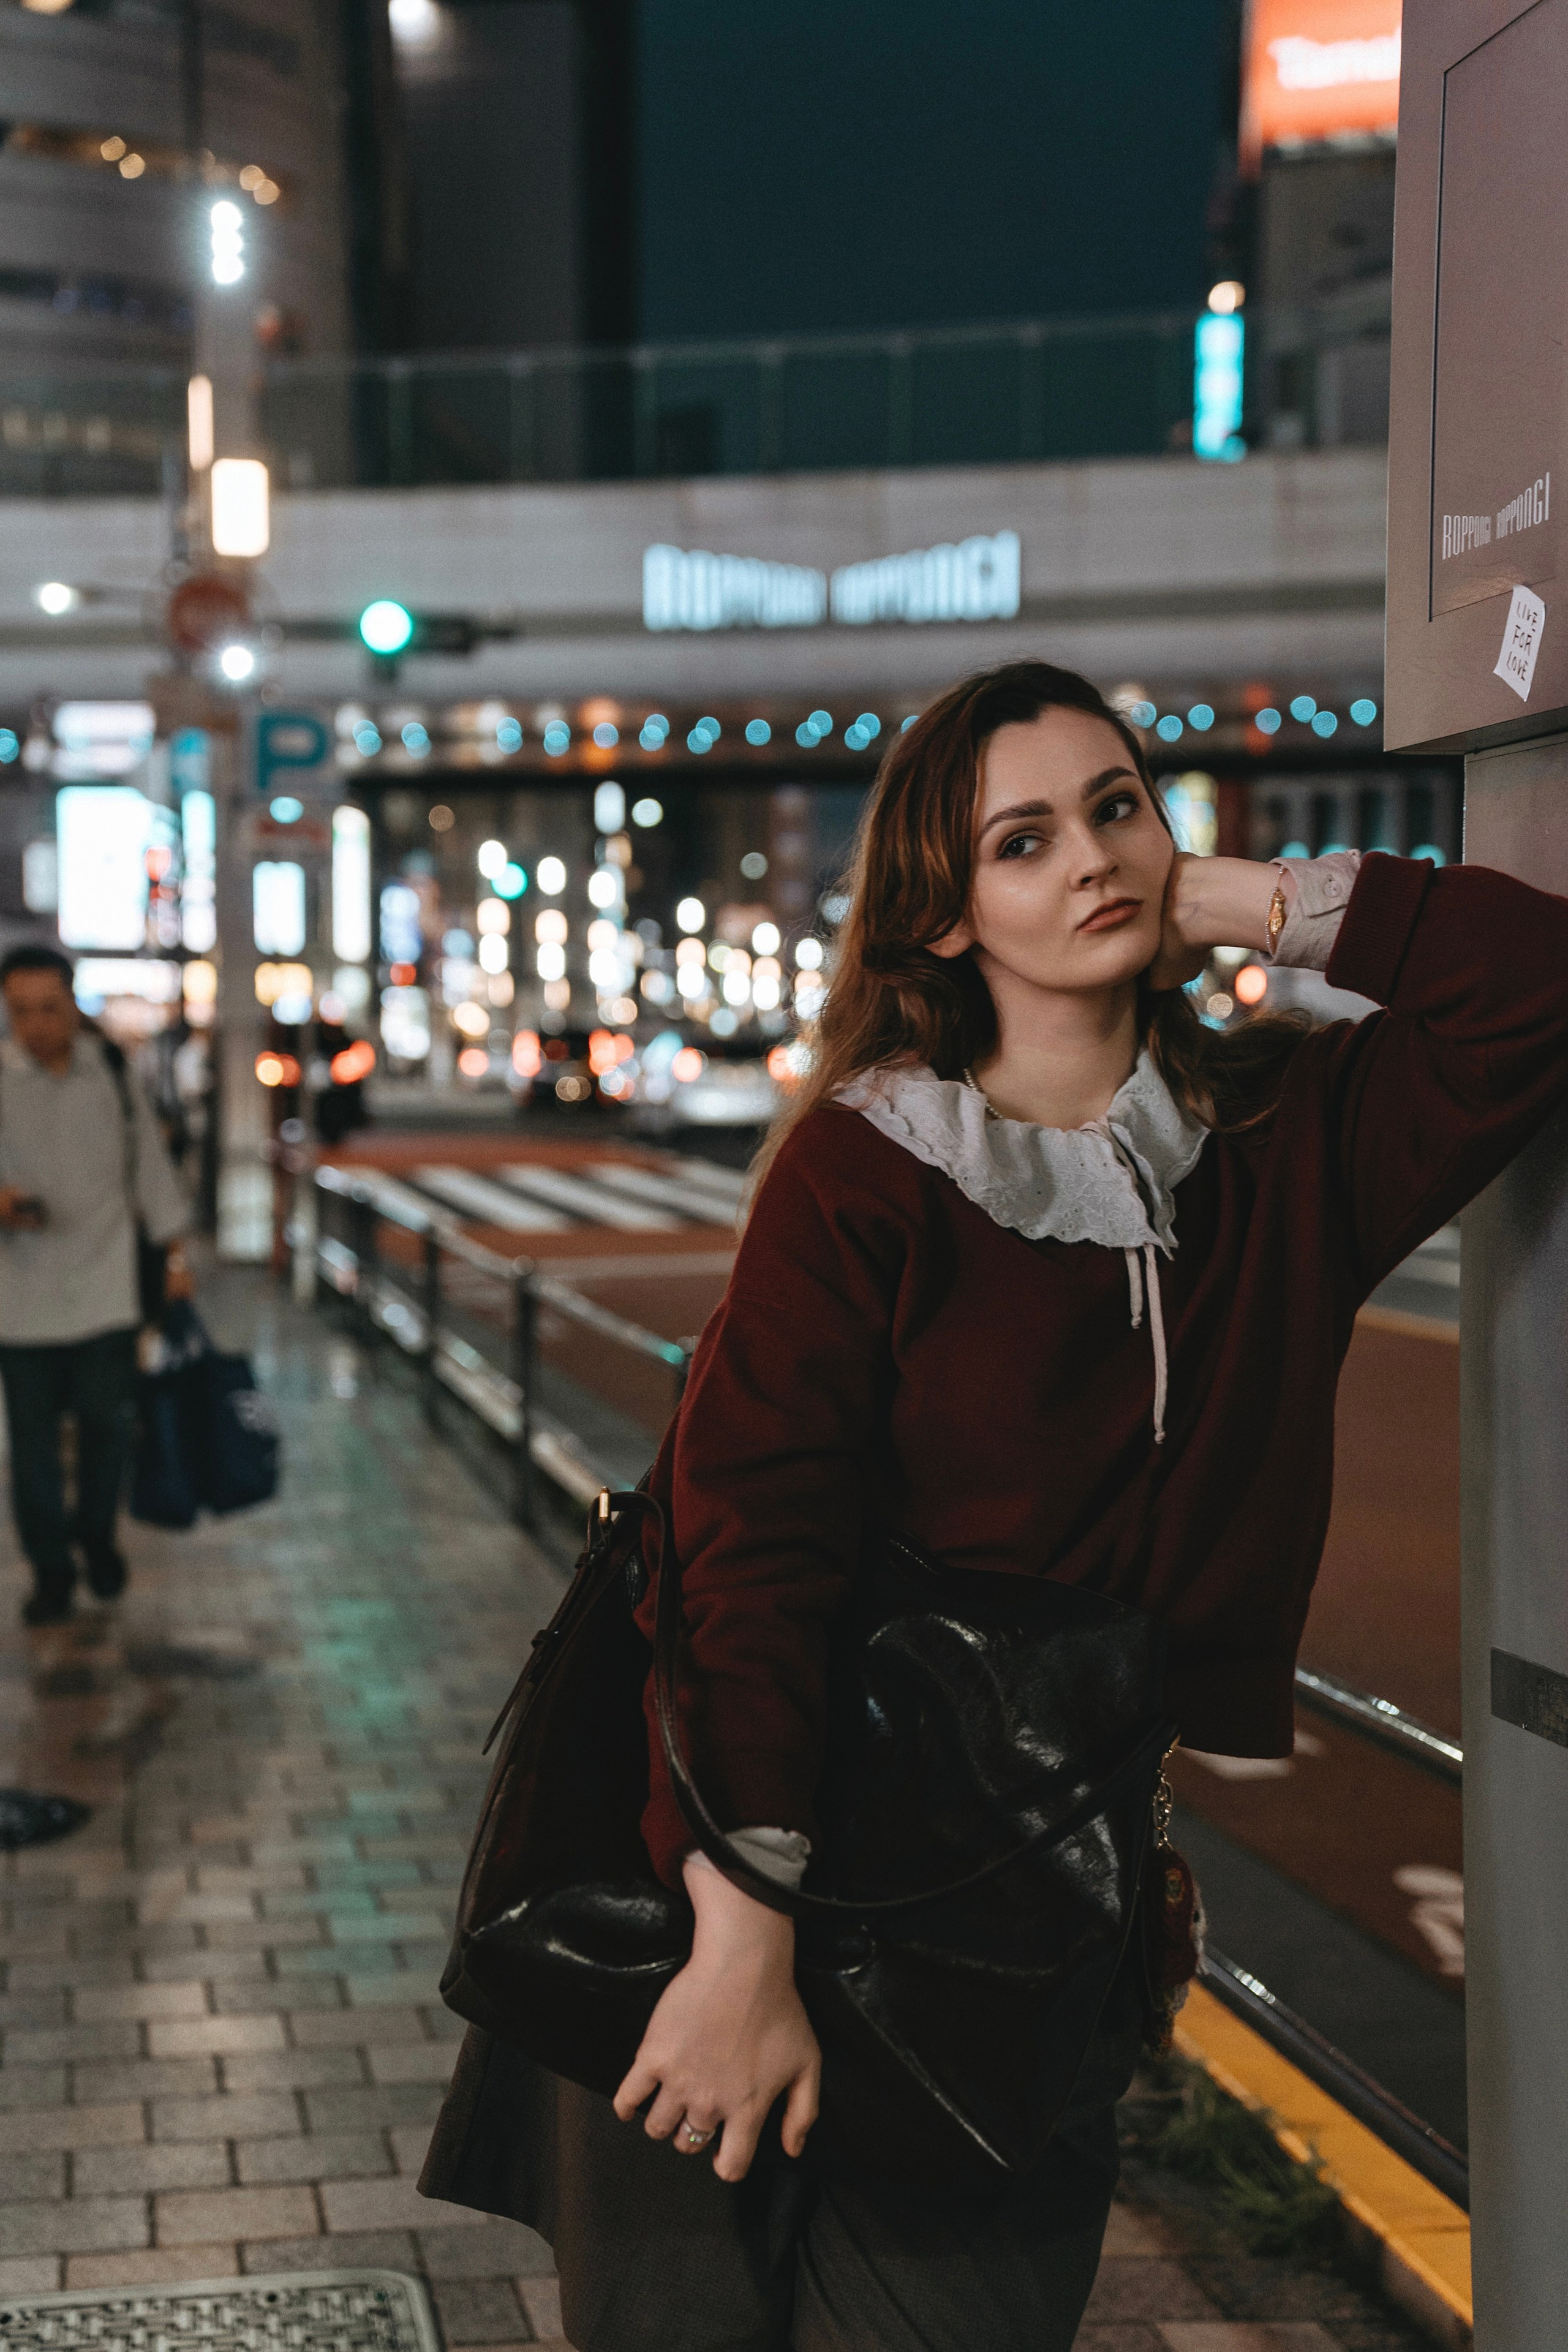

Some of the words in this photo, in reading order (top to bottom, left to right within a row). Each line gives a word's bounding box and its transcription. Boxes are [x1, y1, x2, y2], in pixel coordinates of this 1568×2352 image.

[1517, 601, 1538, 632] LIVE
[1512, 624, 1532, 657] FOR
[1506, 650, 1529, 681] LOVE
[257, 712, 329, 791] P
